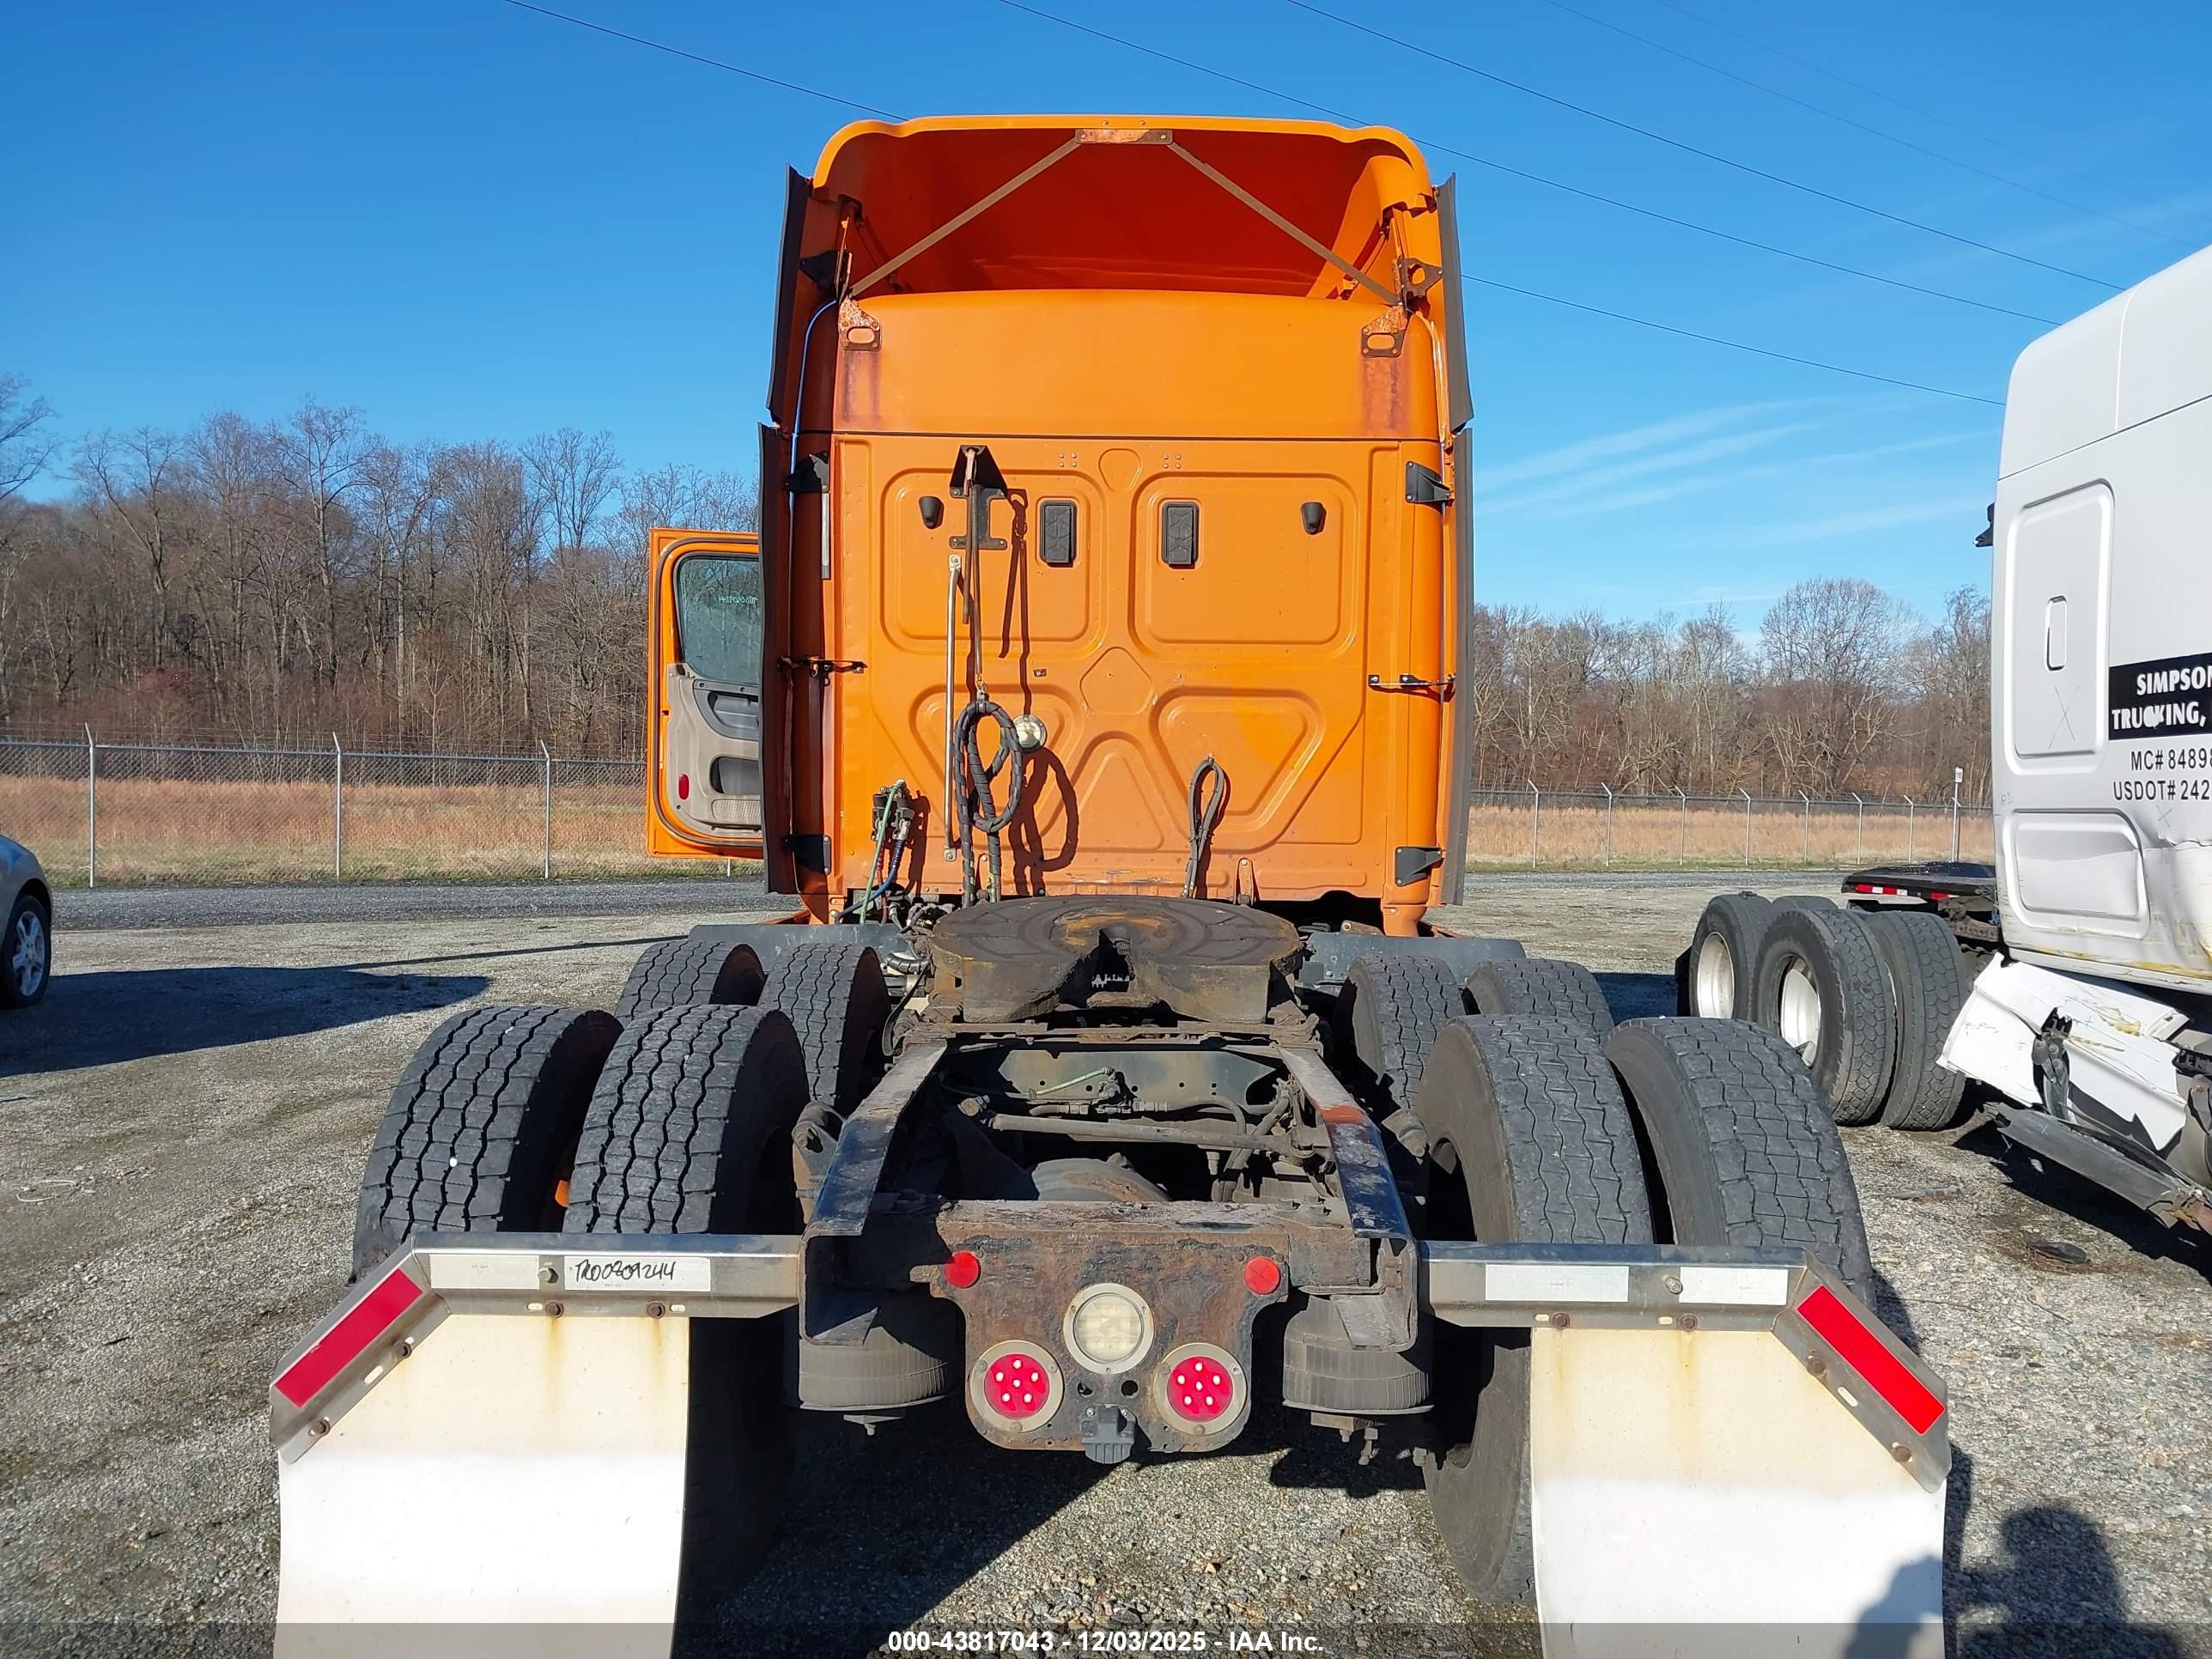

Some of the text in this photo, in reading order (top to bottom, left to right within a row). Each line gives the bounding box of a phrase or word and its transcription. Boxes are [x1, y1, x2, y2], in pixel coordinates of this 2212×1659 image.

[2131, 750, 2164, 770] MC#
[2113, 779, 2210, 800] USDOT# 242
